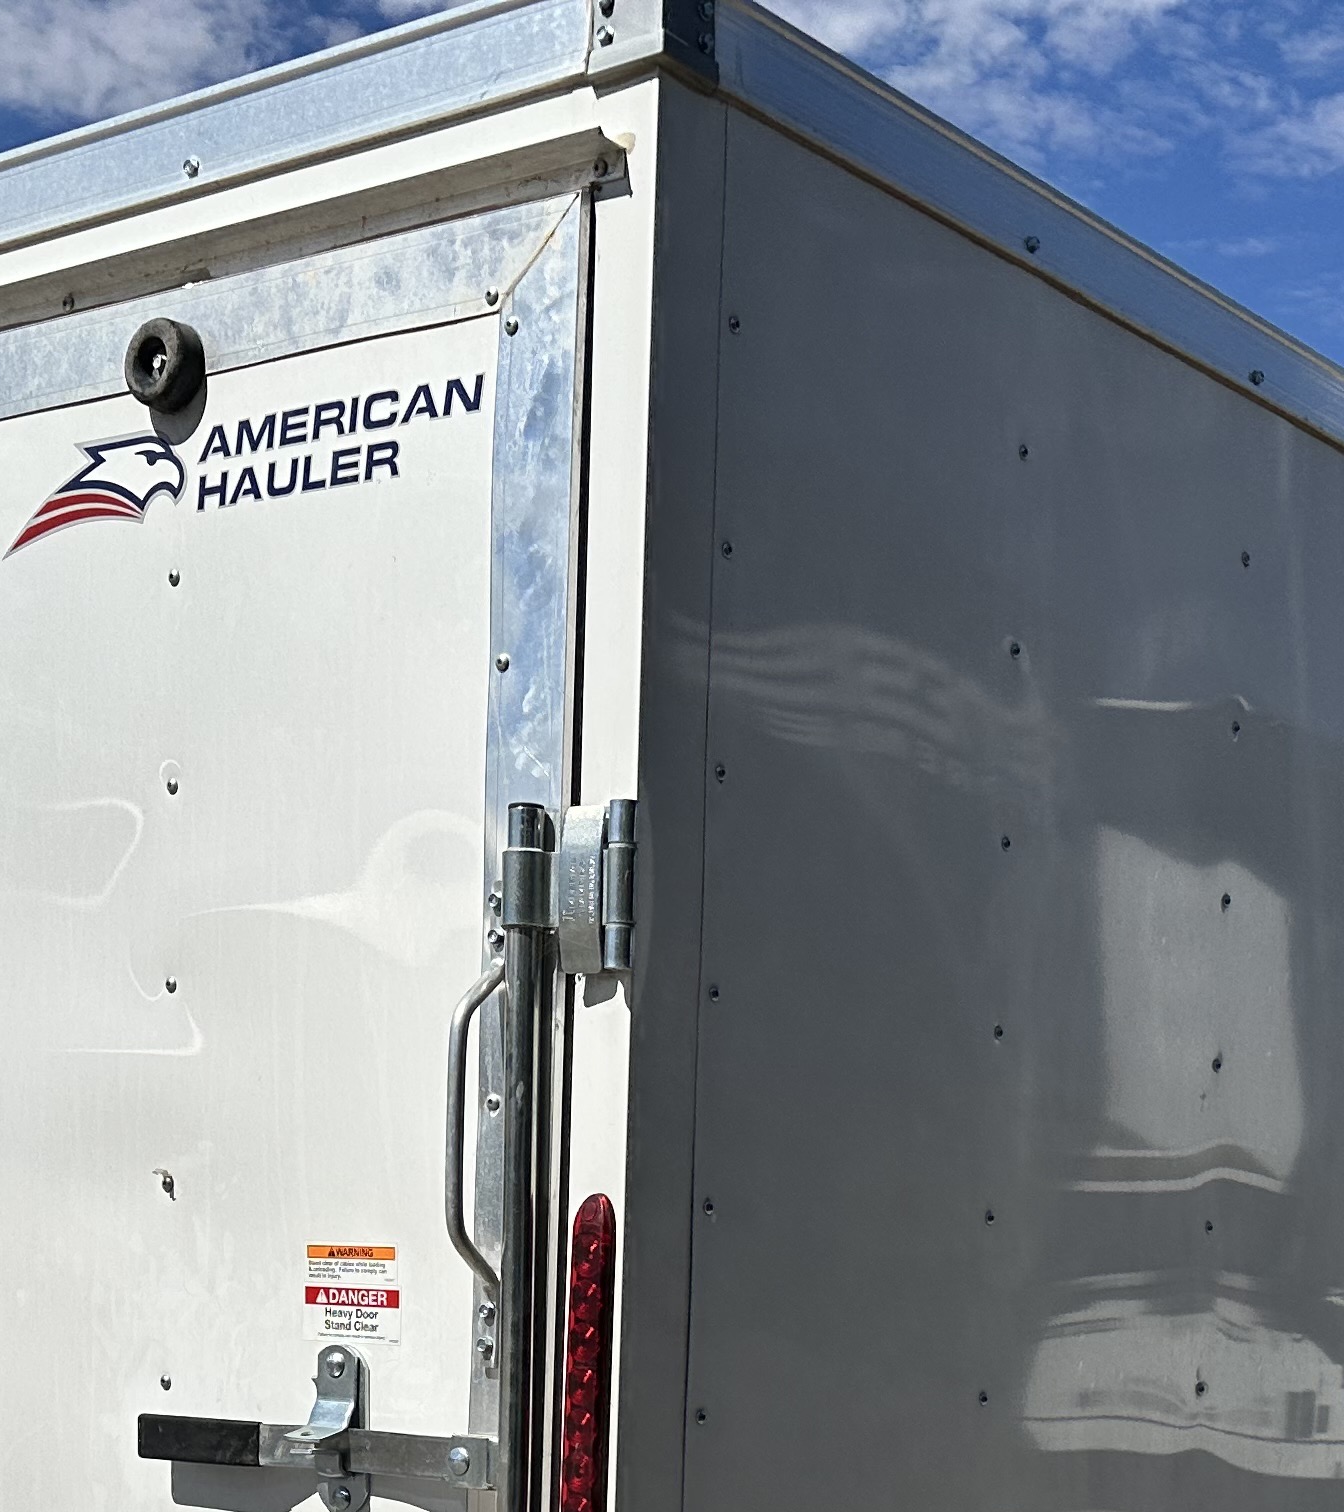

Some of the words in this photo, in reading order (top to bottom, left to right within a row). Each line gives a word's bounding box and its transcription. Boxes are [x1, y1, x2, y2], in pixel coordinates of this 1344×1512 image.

[198, 374, 485, 463] AMERICAN
[197, 440, 401, 513] HAULER
[335, 1248, 374, 1257] WARNING
[329, 1289, 387, 1306] DANGER
[325, 1307, 353, 1320] Heavy
[356, 1309, 378, 1319] Door
[325, 1319, 351, 1331] Stand
[354, 1321, 379, 1332] Clear
